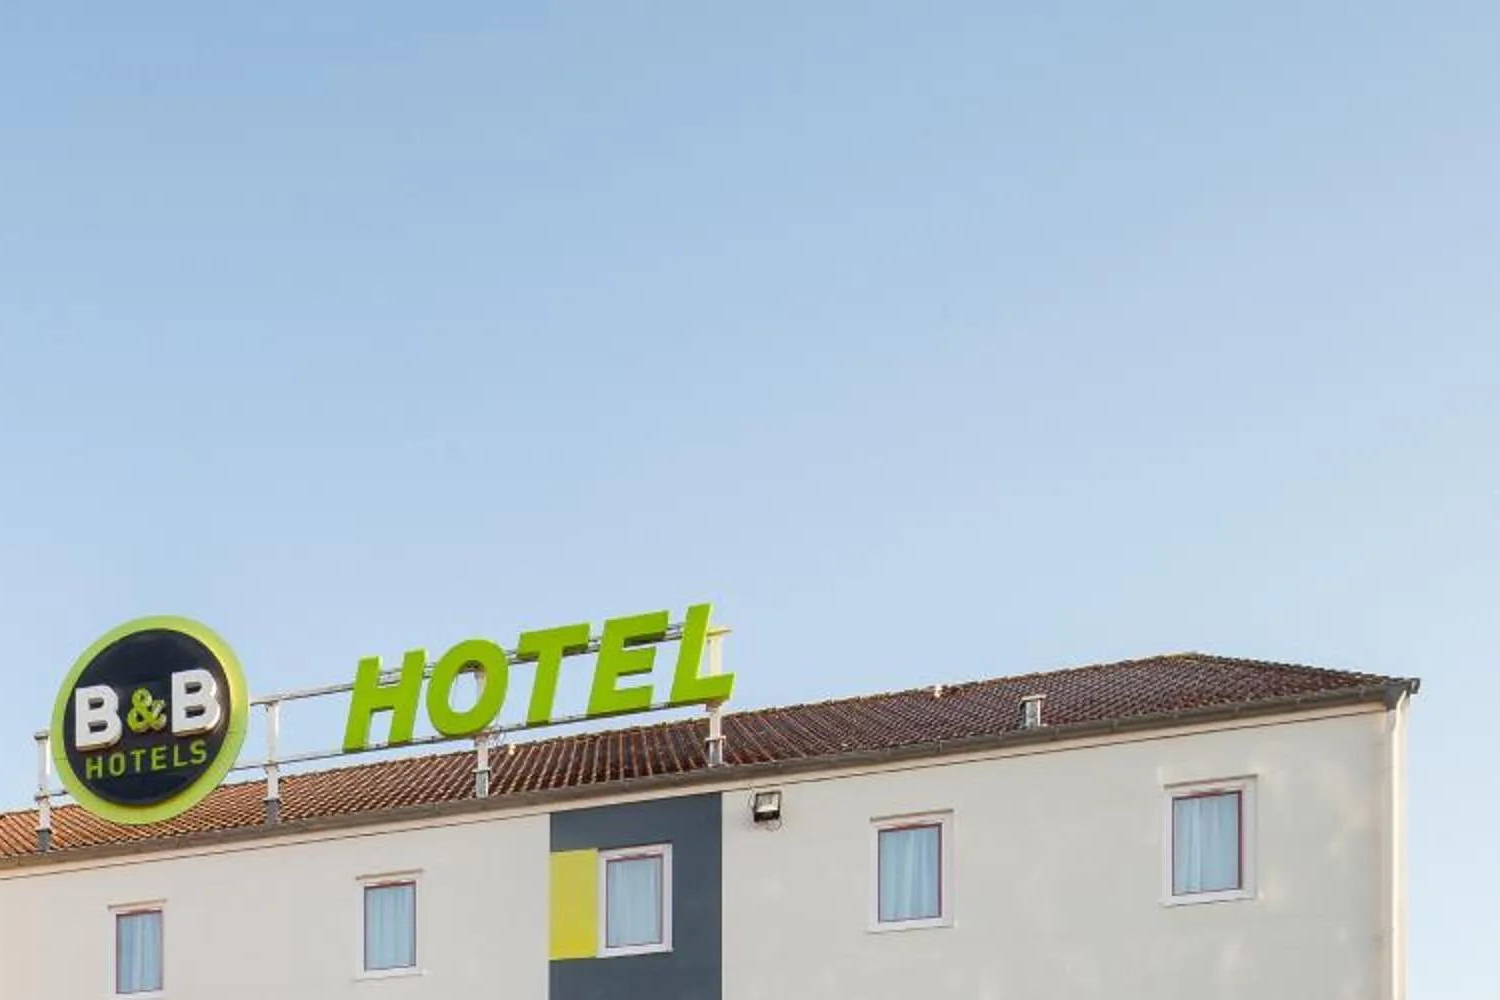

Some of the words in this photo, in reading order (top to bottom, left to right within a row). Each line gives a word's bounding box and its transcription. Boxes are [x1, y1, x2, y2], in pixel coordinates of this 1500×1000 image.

[75, 668, 221, 752] B&B
[343, 603, 735, 754] HOTEL
[85, 739, 208, 780] HOTELS
